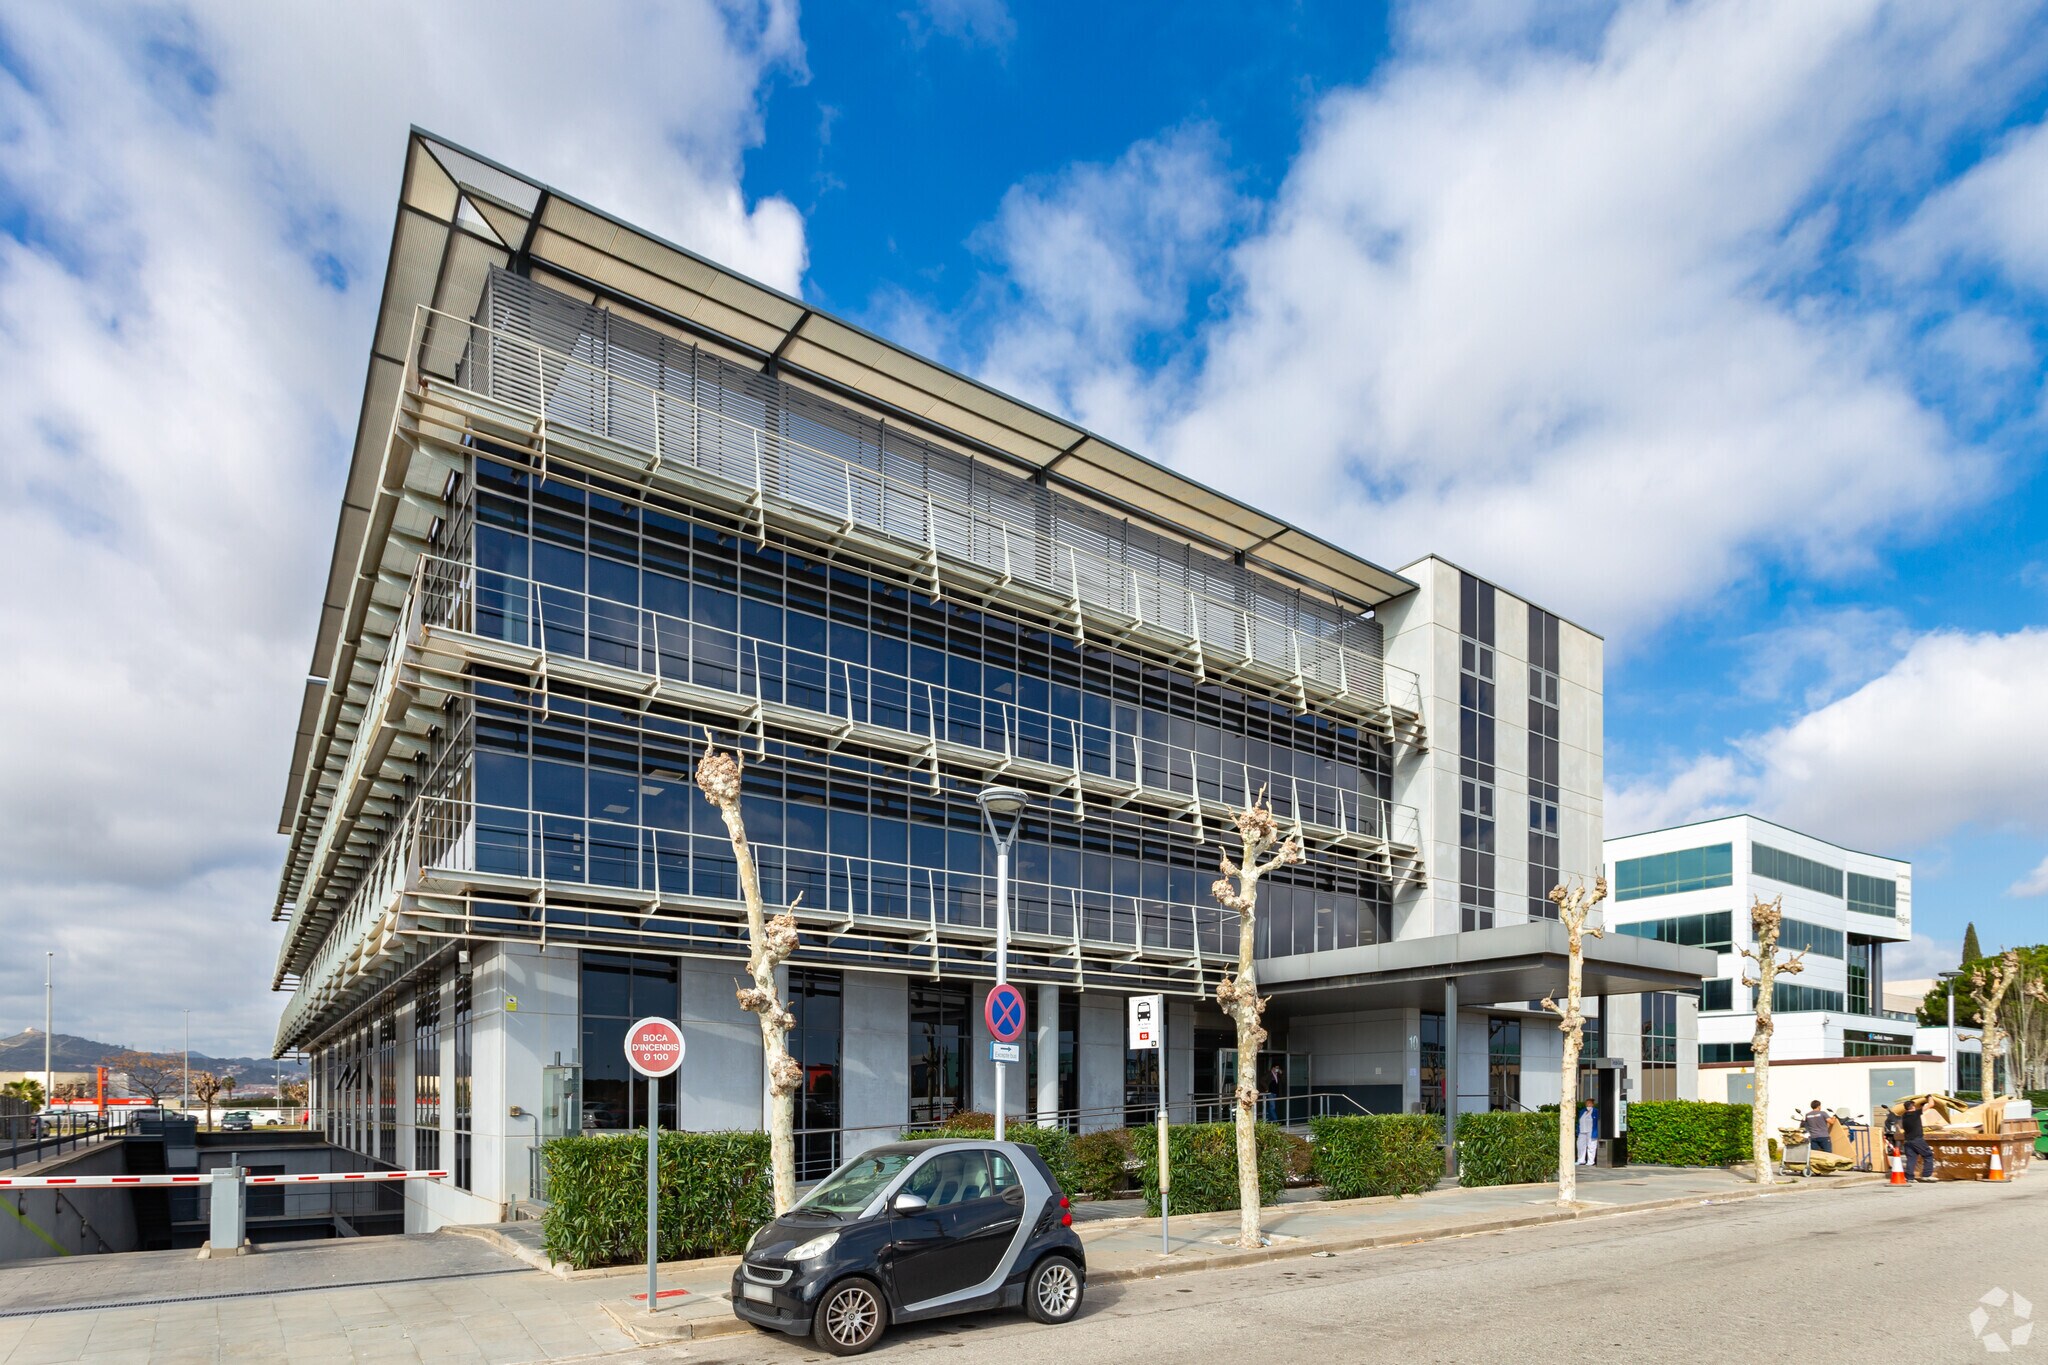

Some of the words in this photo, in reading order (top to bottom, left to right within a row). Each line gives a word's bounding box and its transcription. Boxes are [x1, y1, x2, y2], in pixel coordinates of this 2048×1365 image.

[1409, 1035, 1418, 1050] 10
[632, 1043, 679, 1051] D'INCENDIS
[643, 1053, 650, 1061] Ø
